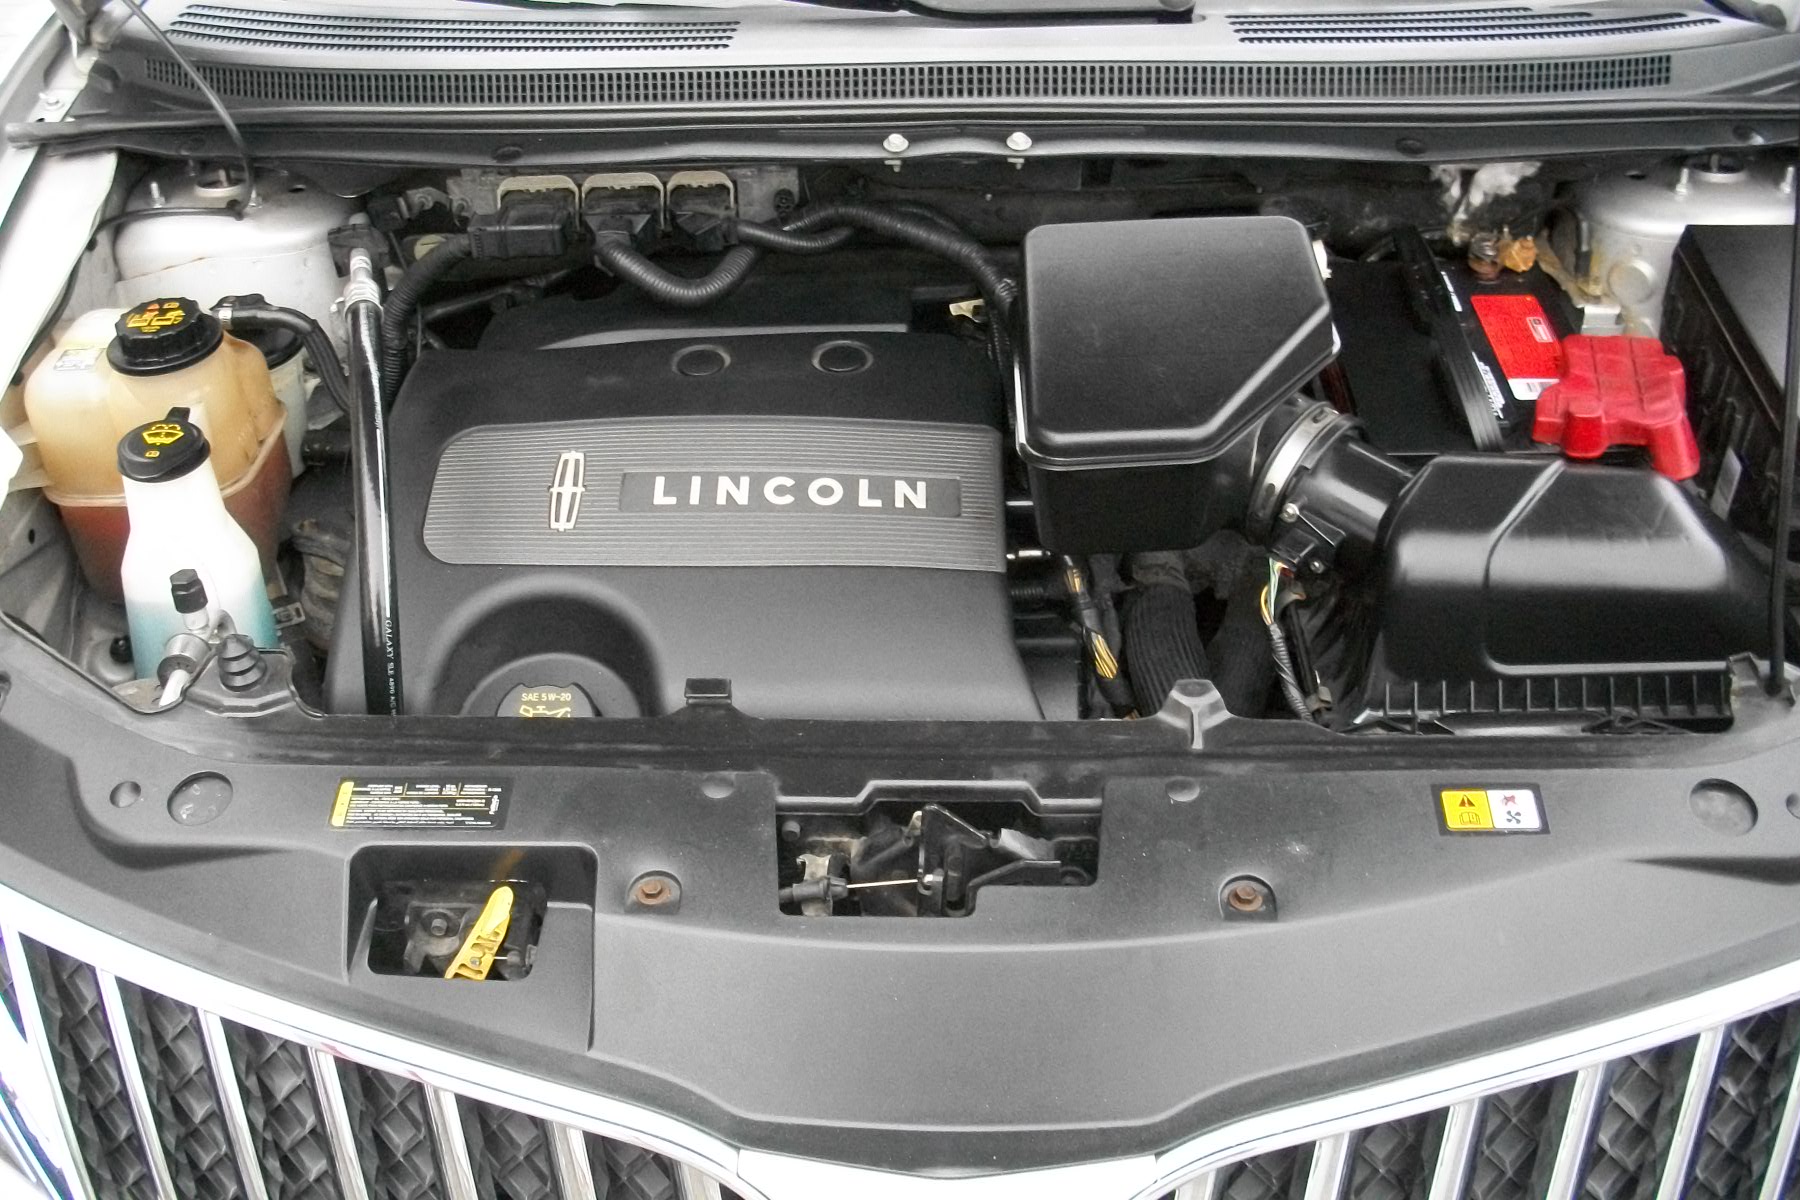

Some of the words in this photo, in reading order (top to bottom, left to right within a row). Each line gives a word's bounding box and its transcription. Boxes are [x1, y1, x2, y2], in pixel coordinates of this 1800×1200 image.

[652, 475, 928, 509] LINCOLN
[385, 620, 394, 659] GALAXY
[521, 692, 540, 702] SAE
[541, 692, 572, 702] 5W-20
